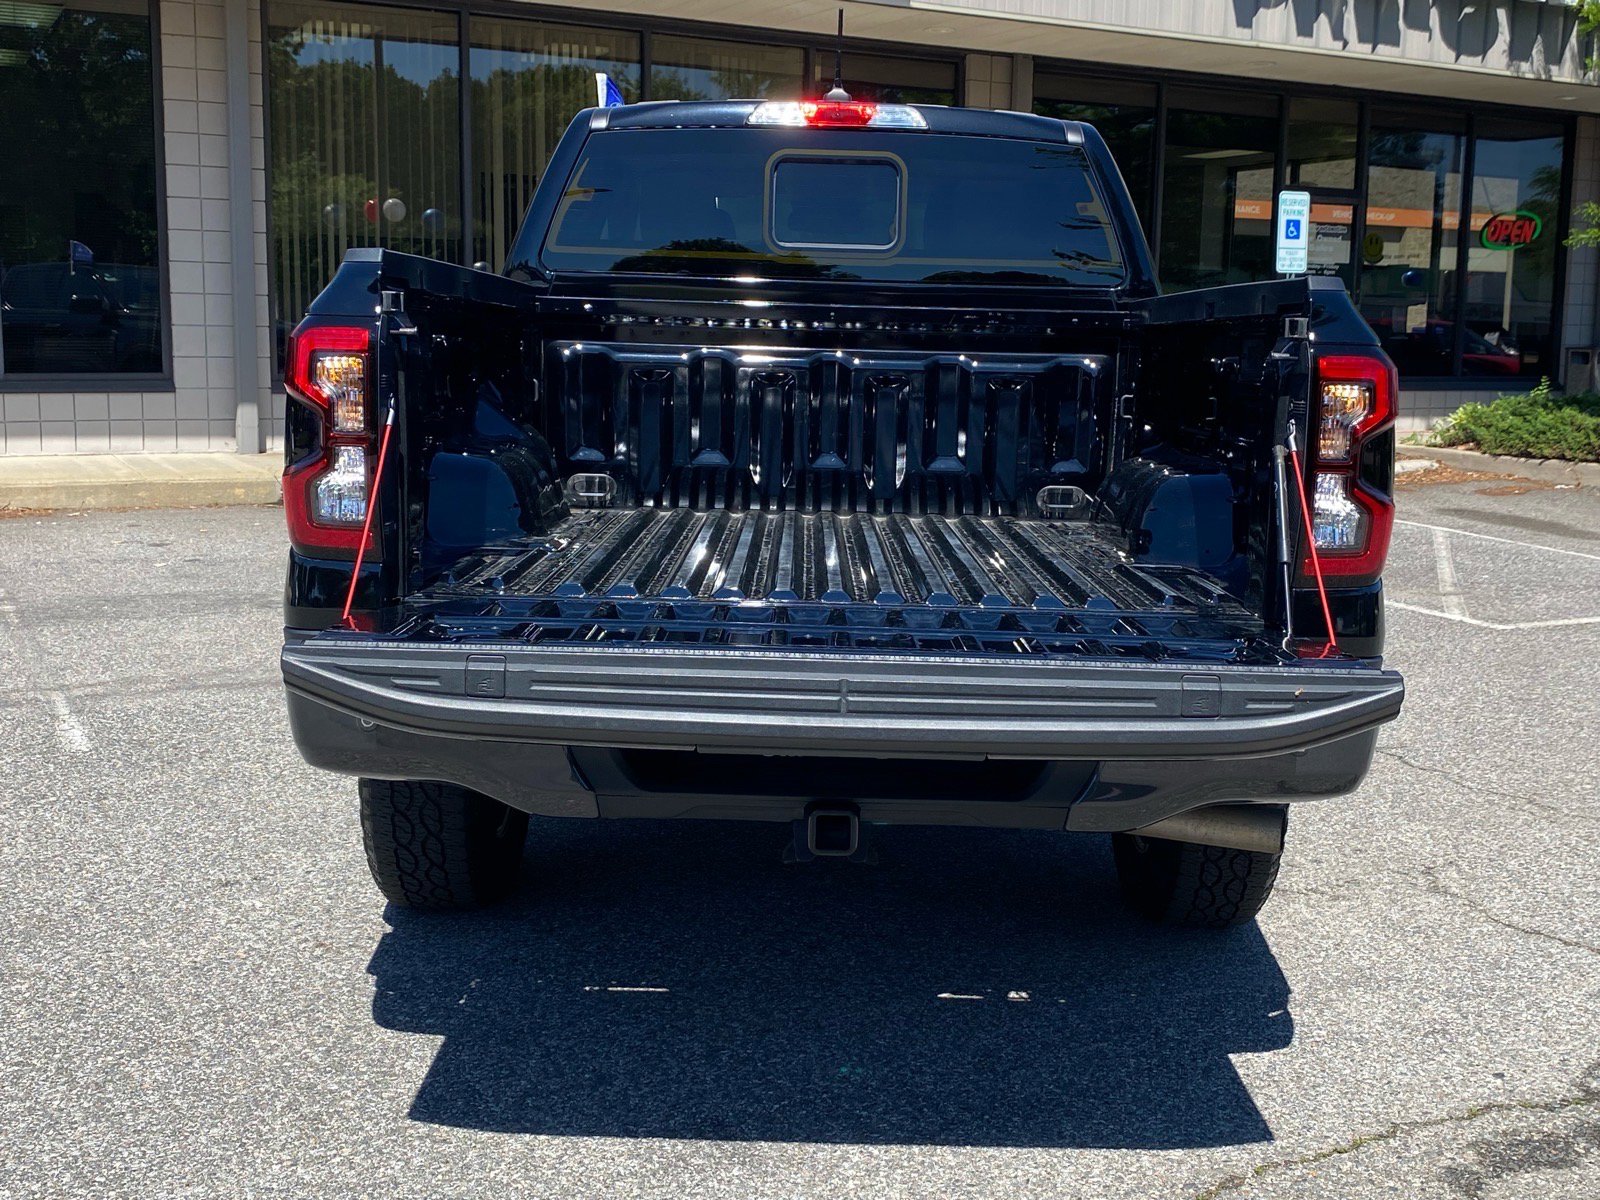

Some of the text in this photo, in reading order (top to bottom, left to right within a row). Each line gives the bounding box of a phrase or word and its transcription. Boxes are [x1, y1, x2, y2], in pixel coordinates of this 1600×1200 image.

[1280, 198, 1307, 207] RESERVED
[1282, 208, 1305, 217] PARKING
[1487, 219, 1535, 243] OPEN
